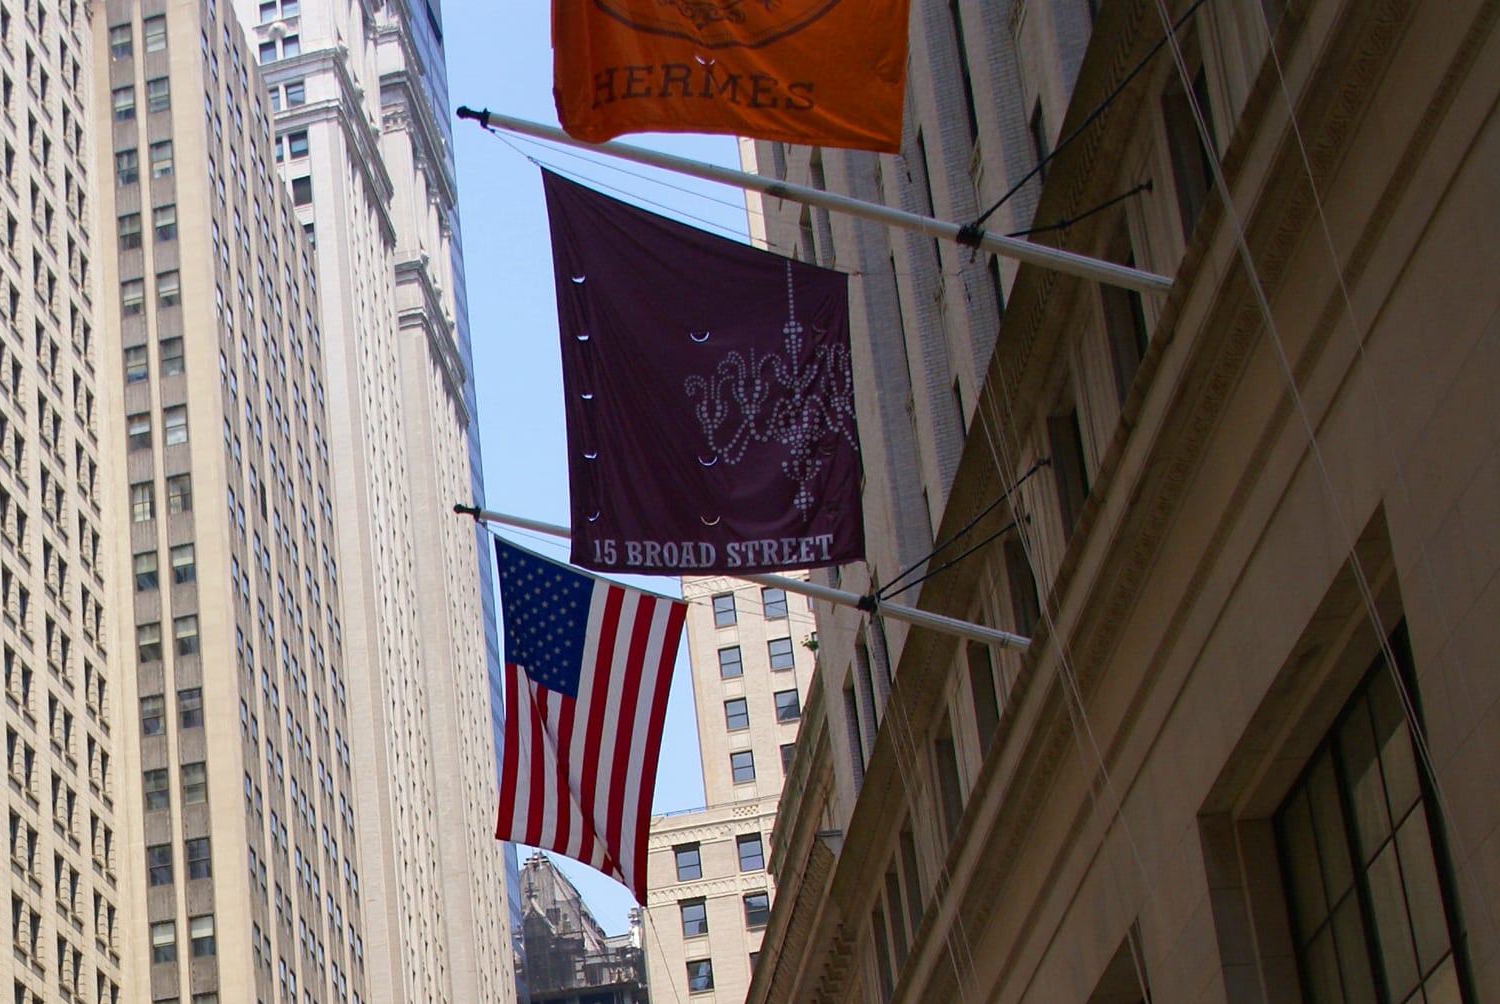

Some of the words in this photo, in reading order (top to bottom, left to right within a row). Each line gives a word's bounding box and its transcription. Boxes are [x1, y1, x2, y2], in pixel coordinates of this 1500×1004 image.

[593, 539, 617, 564] 15
[625, 541, 716, 567] BROAD
[726, 534, 833, 567] STREET
